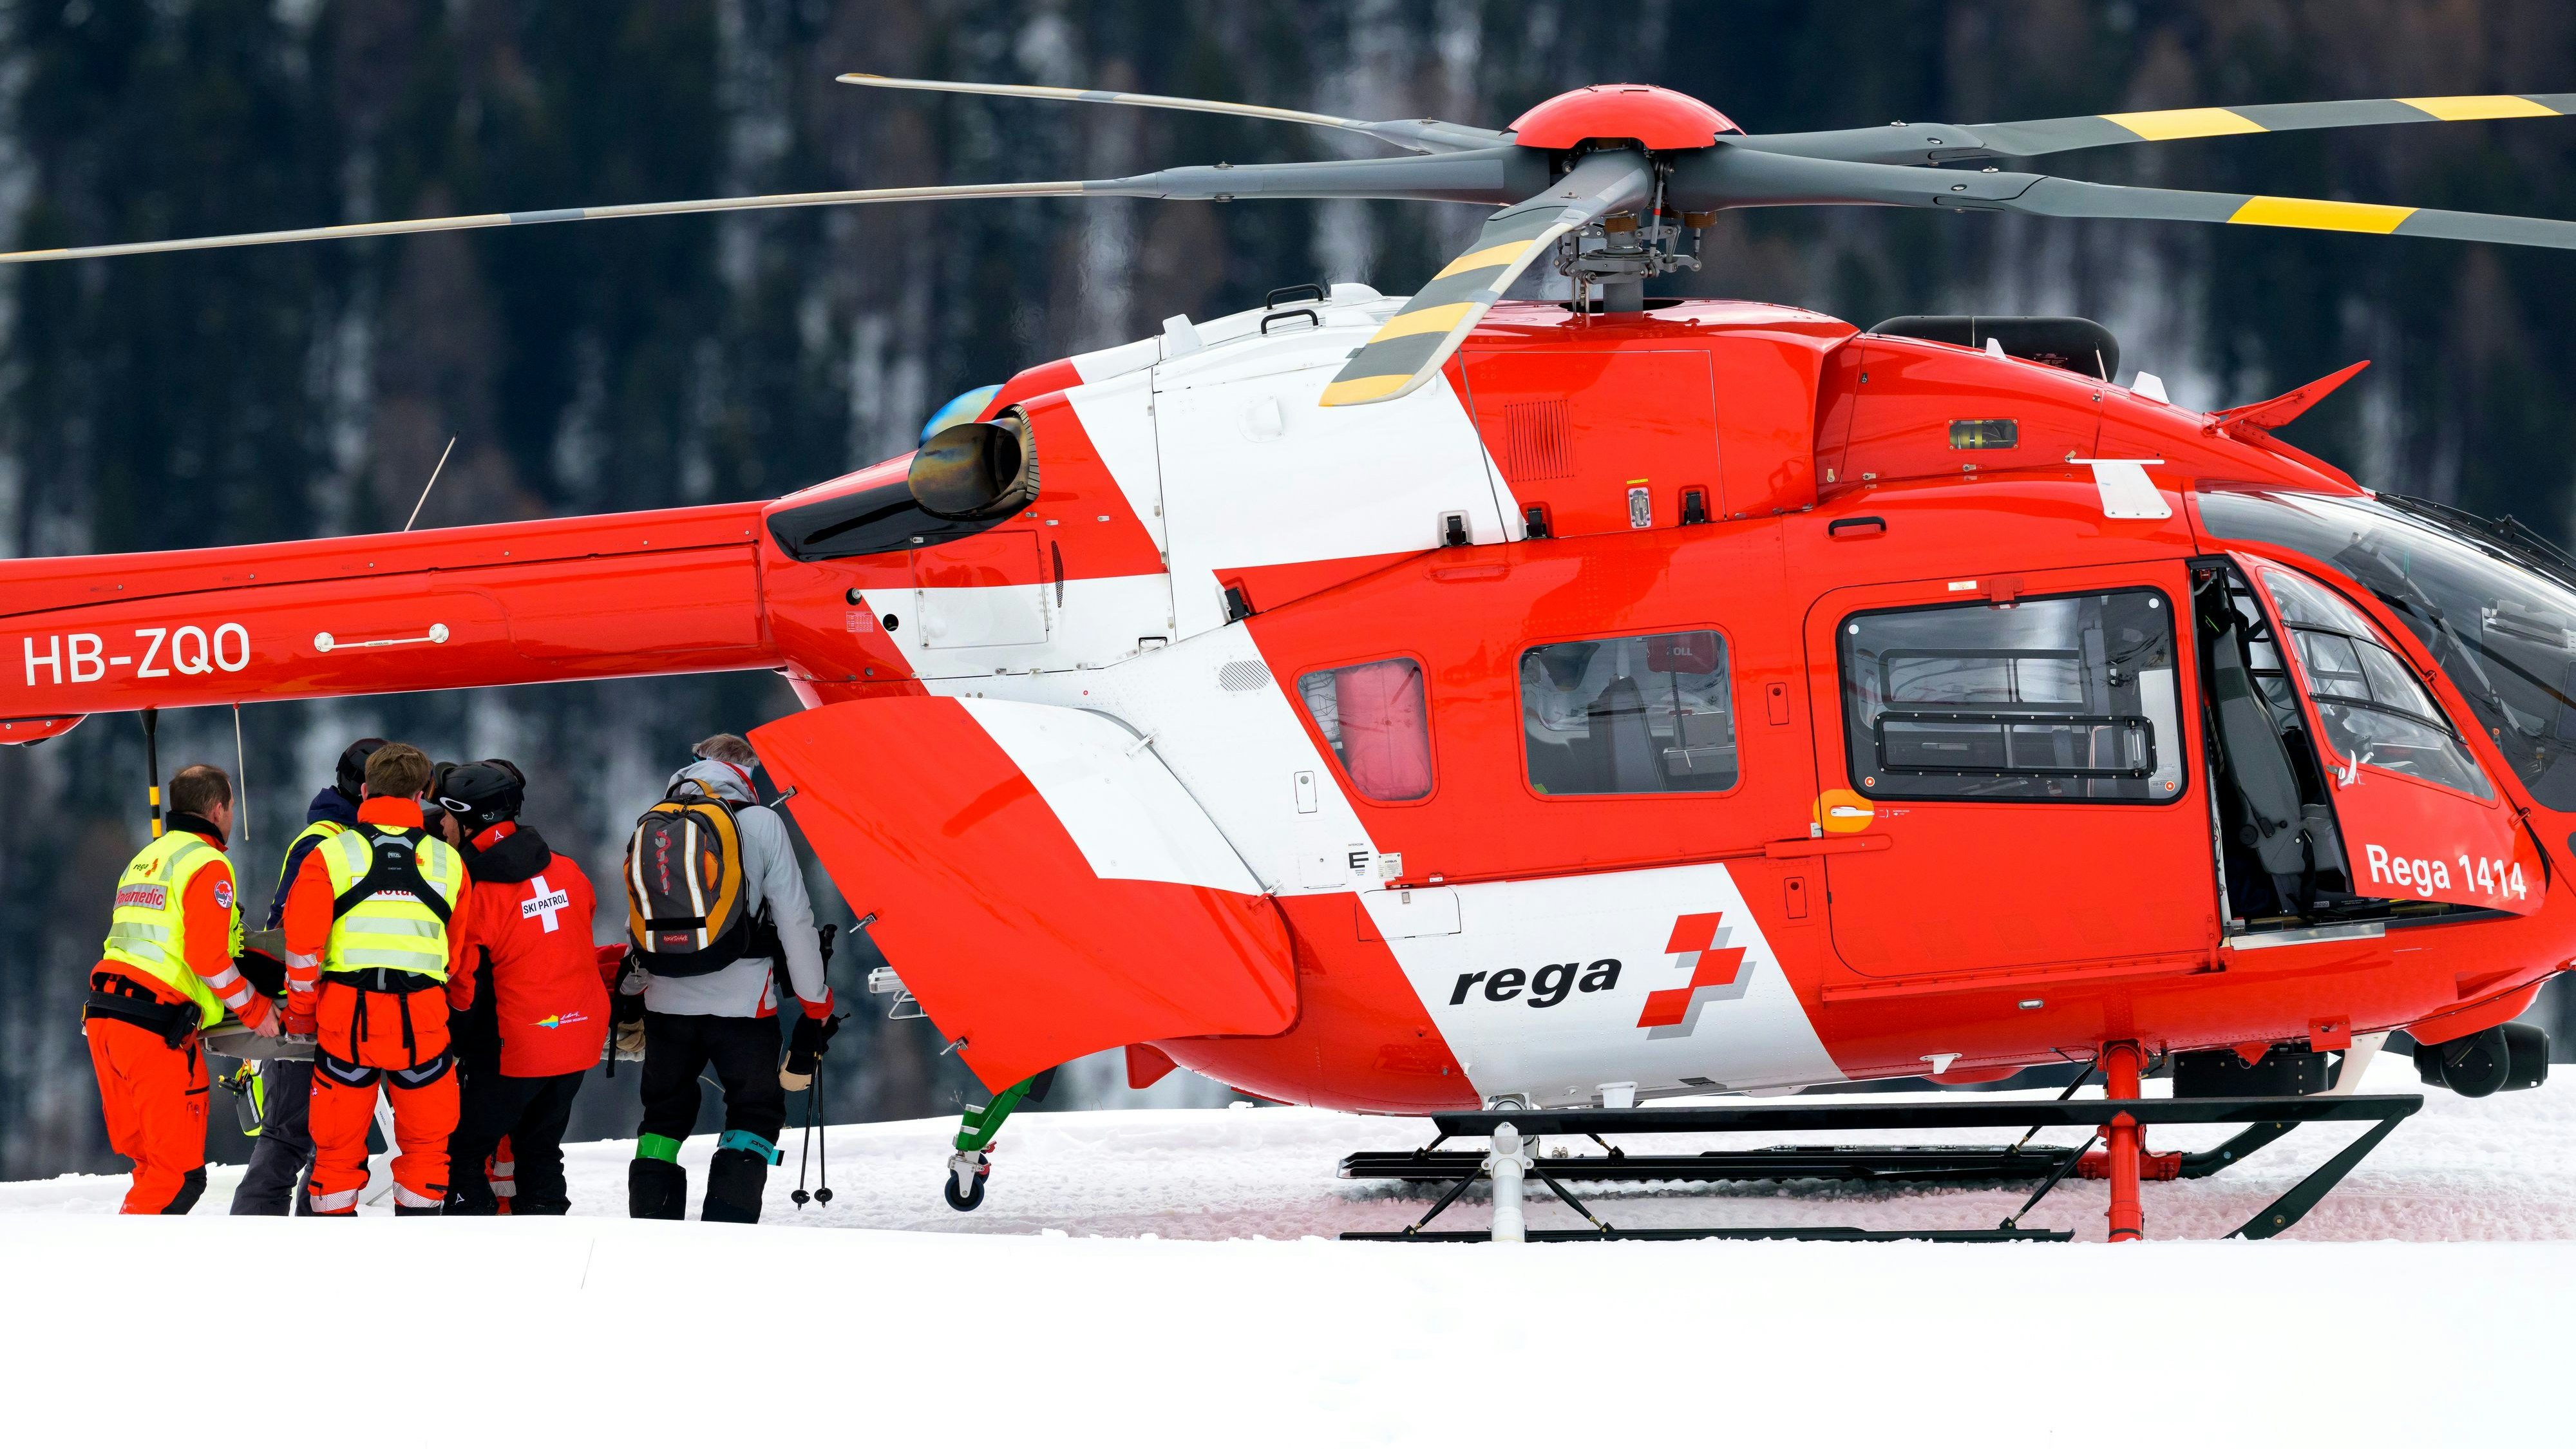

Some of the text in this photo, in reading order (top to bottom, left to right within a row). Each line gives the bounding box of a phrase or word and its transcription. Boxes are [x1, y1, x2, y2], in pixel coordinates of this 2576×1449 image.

[24, 622, 250, 687] HB-ZQO
[1349, 851, 1369, 869] E
[2365, 844, 2528, 900] Rega 1414
[117, 888, 164, 905] Paramedic
[523, 894, 567, 914] SKI PATROL
[1449, 958, 1622, 1009] rega
